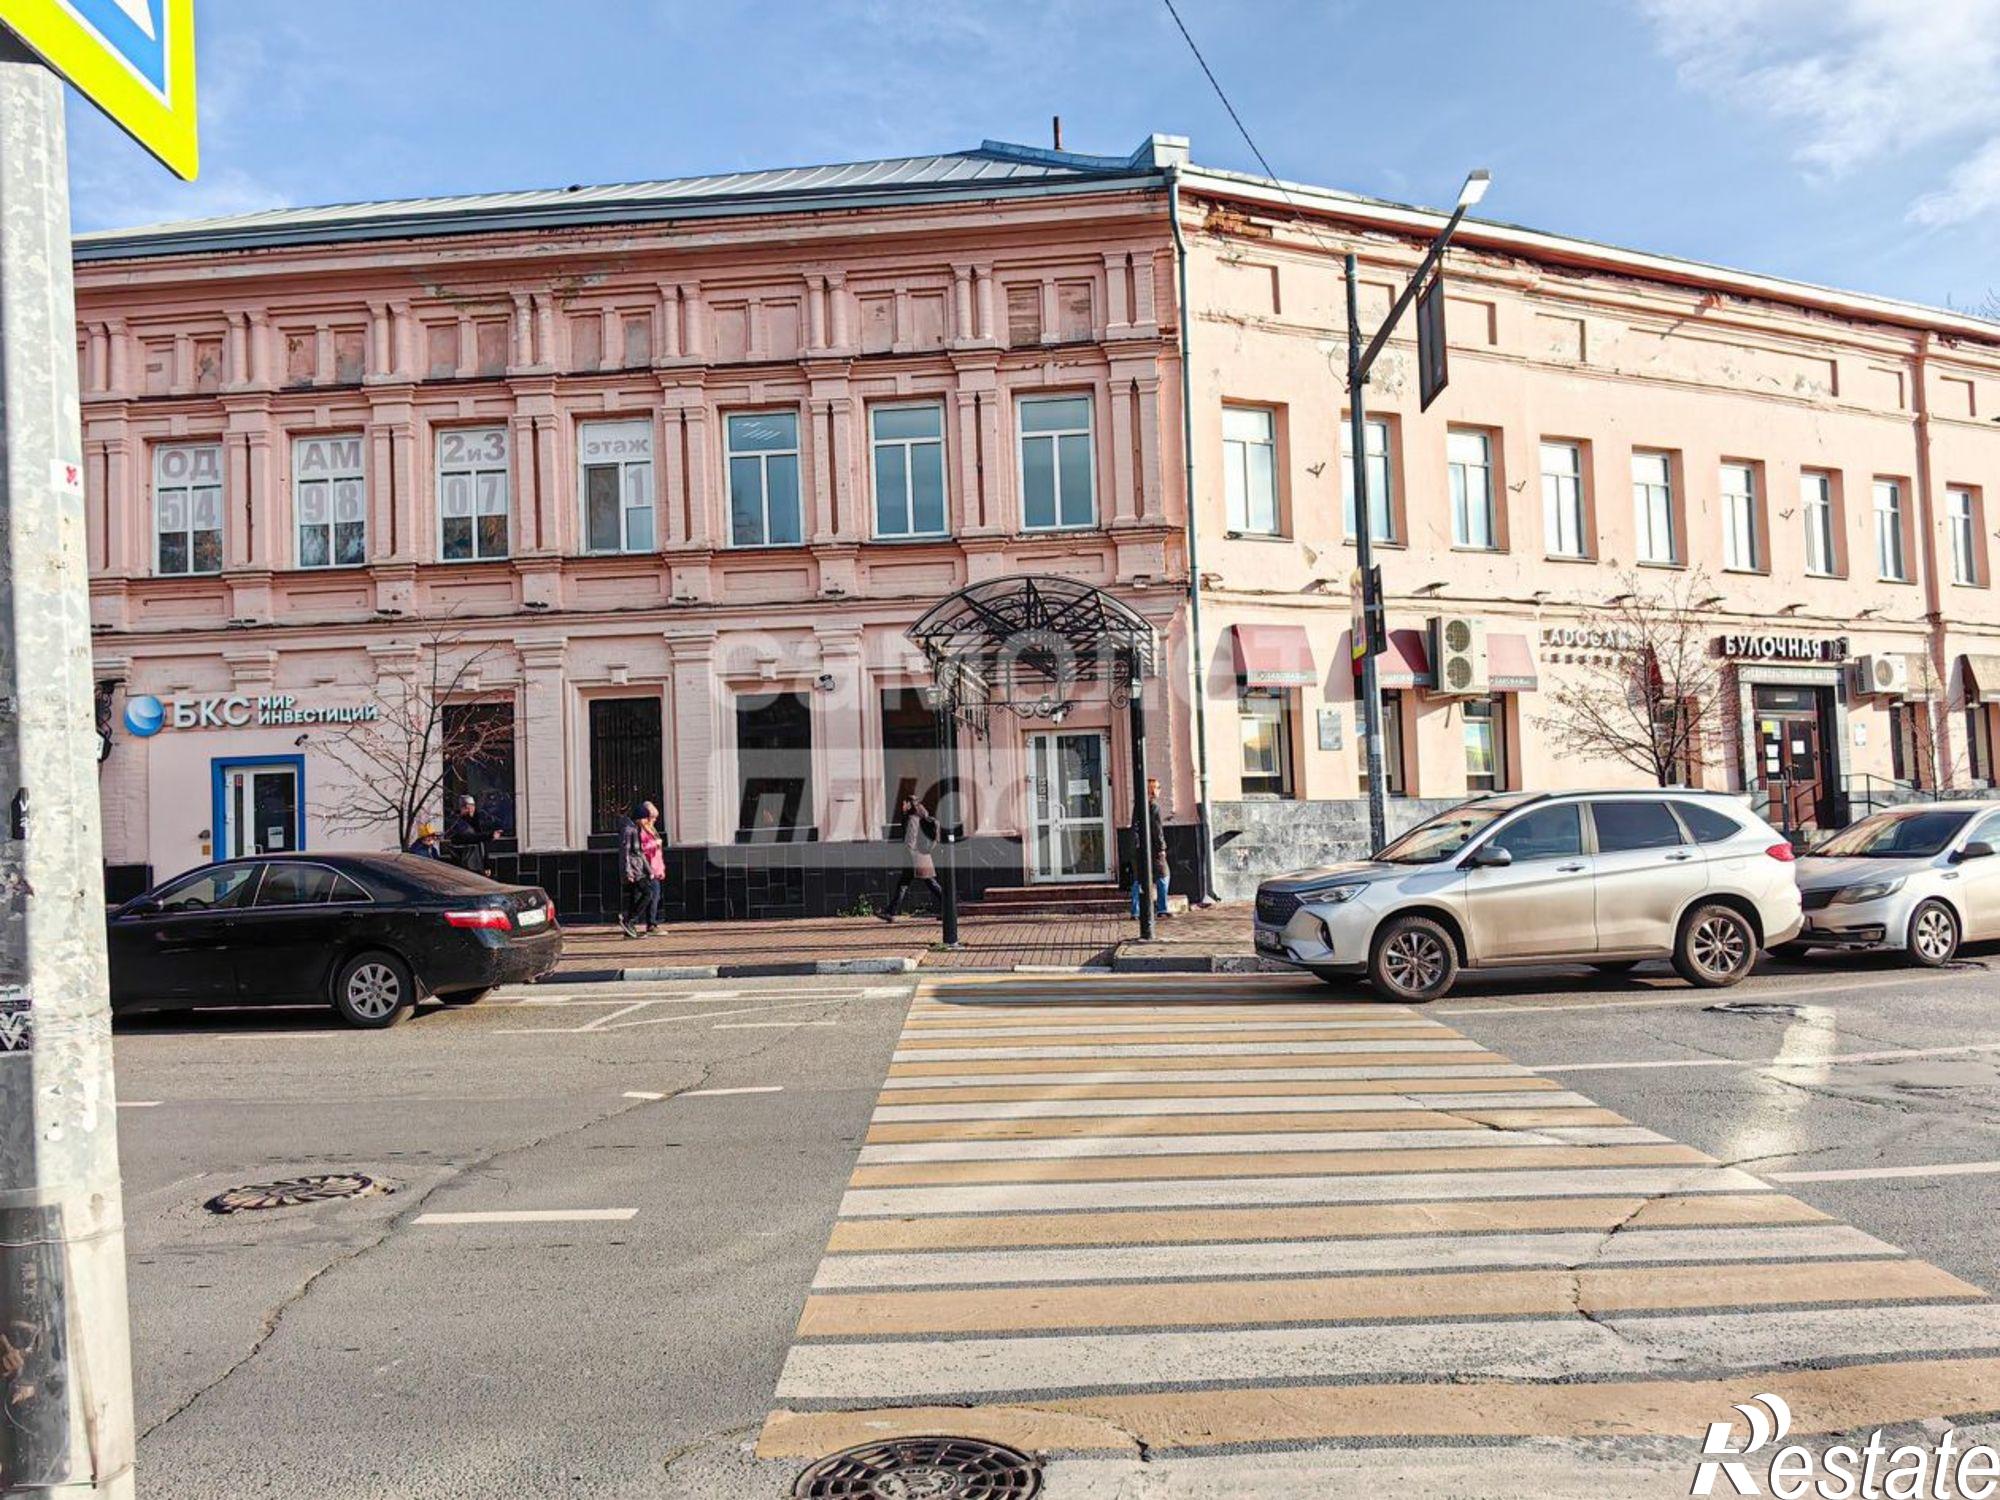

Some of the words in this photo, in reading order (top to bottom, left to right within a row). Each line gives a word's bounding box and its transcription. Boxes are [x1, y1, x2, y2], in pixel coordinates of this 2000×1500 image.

[587, 437, 649, 455] этаж
[303, 484, 360, 522] 98
[447, 476, 499, 515] 07
[1725, 634, 1822, 658] БУЛОЧНАЯ
[173, 697, 250, 729] БКС
[257, 696, 296, 711] МИР
[257, 704, 379, 725] ИНВЕСТИЦИЙ
